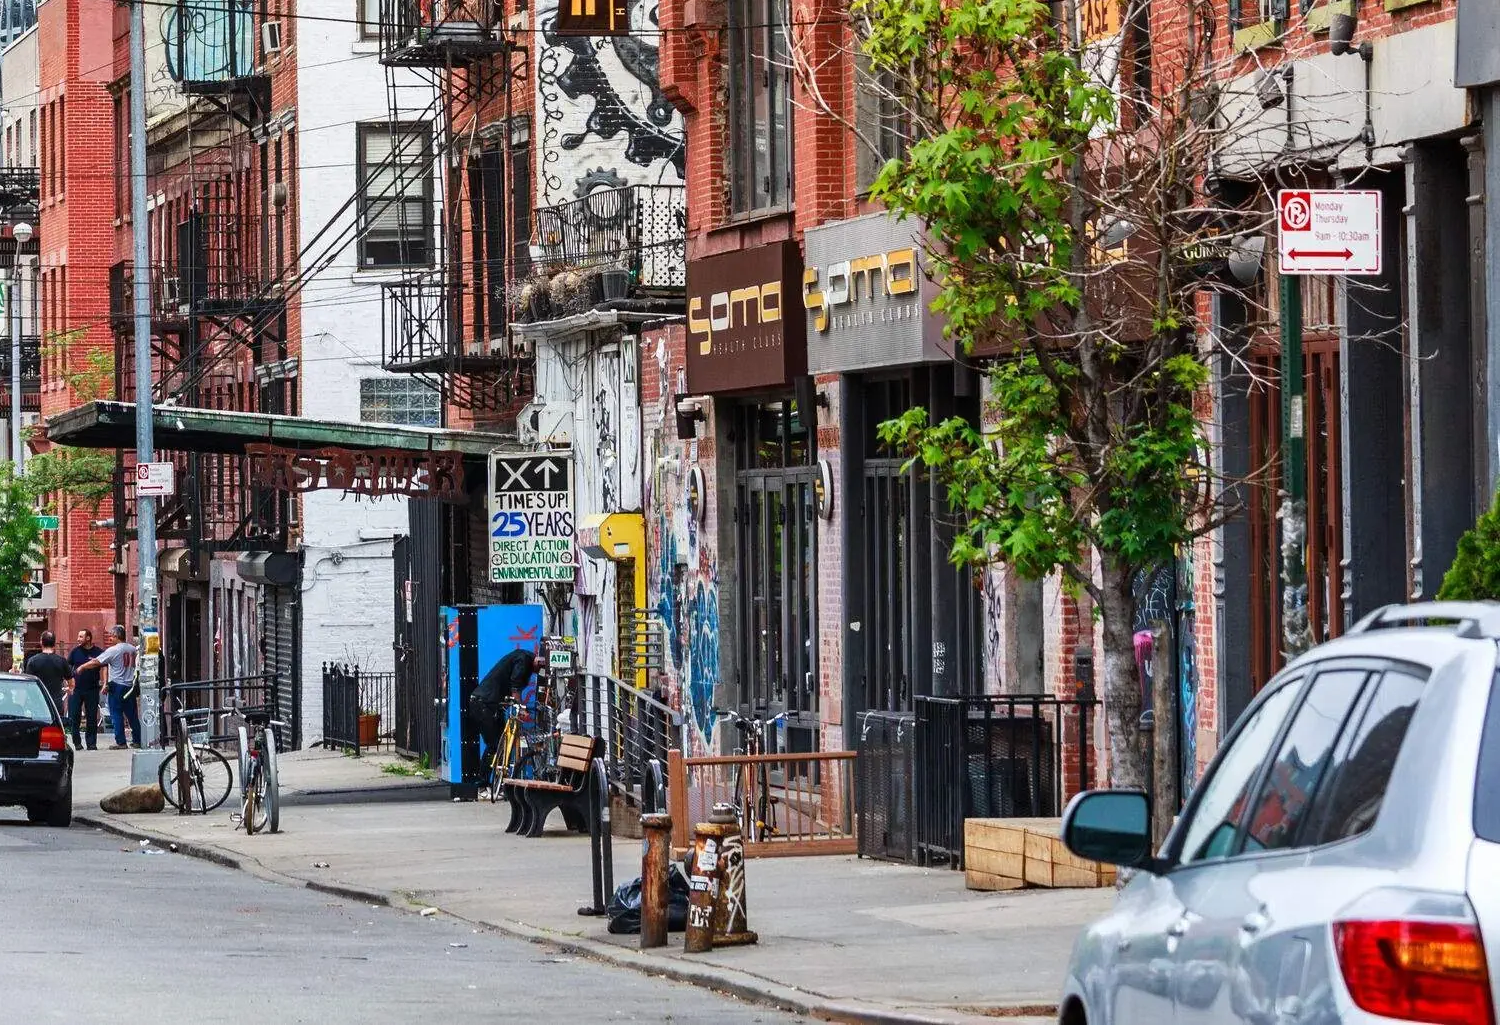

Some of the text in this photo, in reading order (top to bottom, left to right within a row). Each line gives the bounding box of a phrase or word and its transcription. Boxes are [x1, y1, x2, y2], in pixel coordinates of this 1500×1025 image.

[1314, 201, 1344, 212] Monday
[1314, 213, 1349, 226] Thursday
[803, 246, 918, 333] soma
[688, 280, 782, 356] soma
[495, 492, 545, 509] TIME'S
[492, 539, 569, 552] DIRECT ACTION
[502, 551, 559, 565] EDUCATION
[492, 567, 553, 579] ENVIRONMENTAL
[550, 654, 570, 663] ATM
